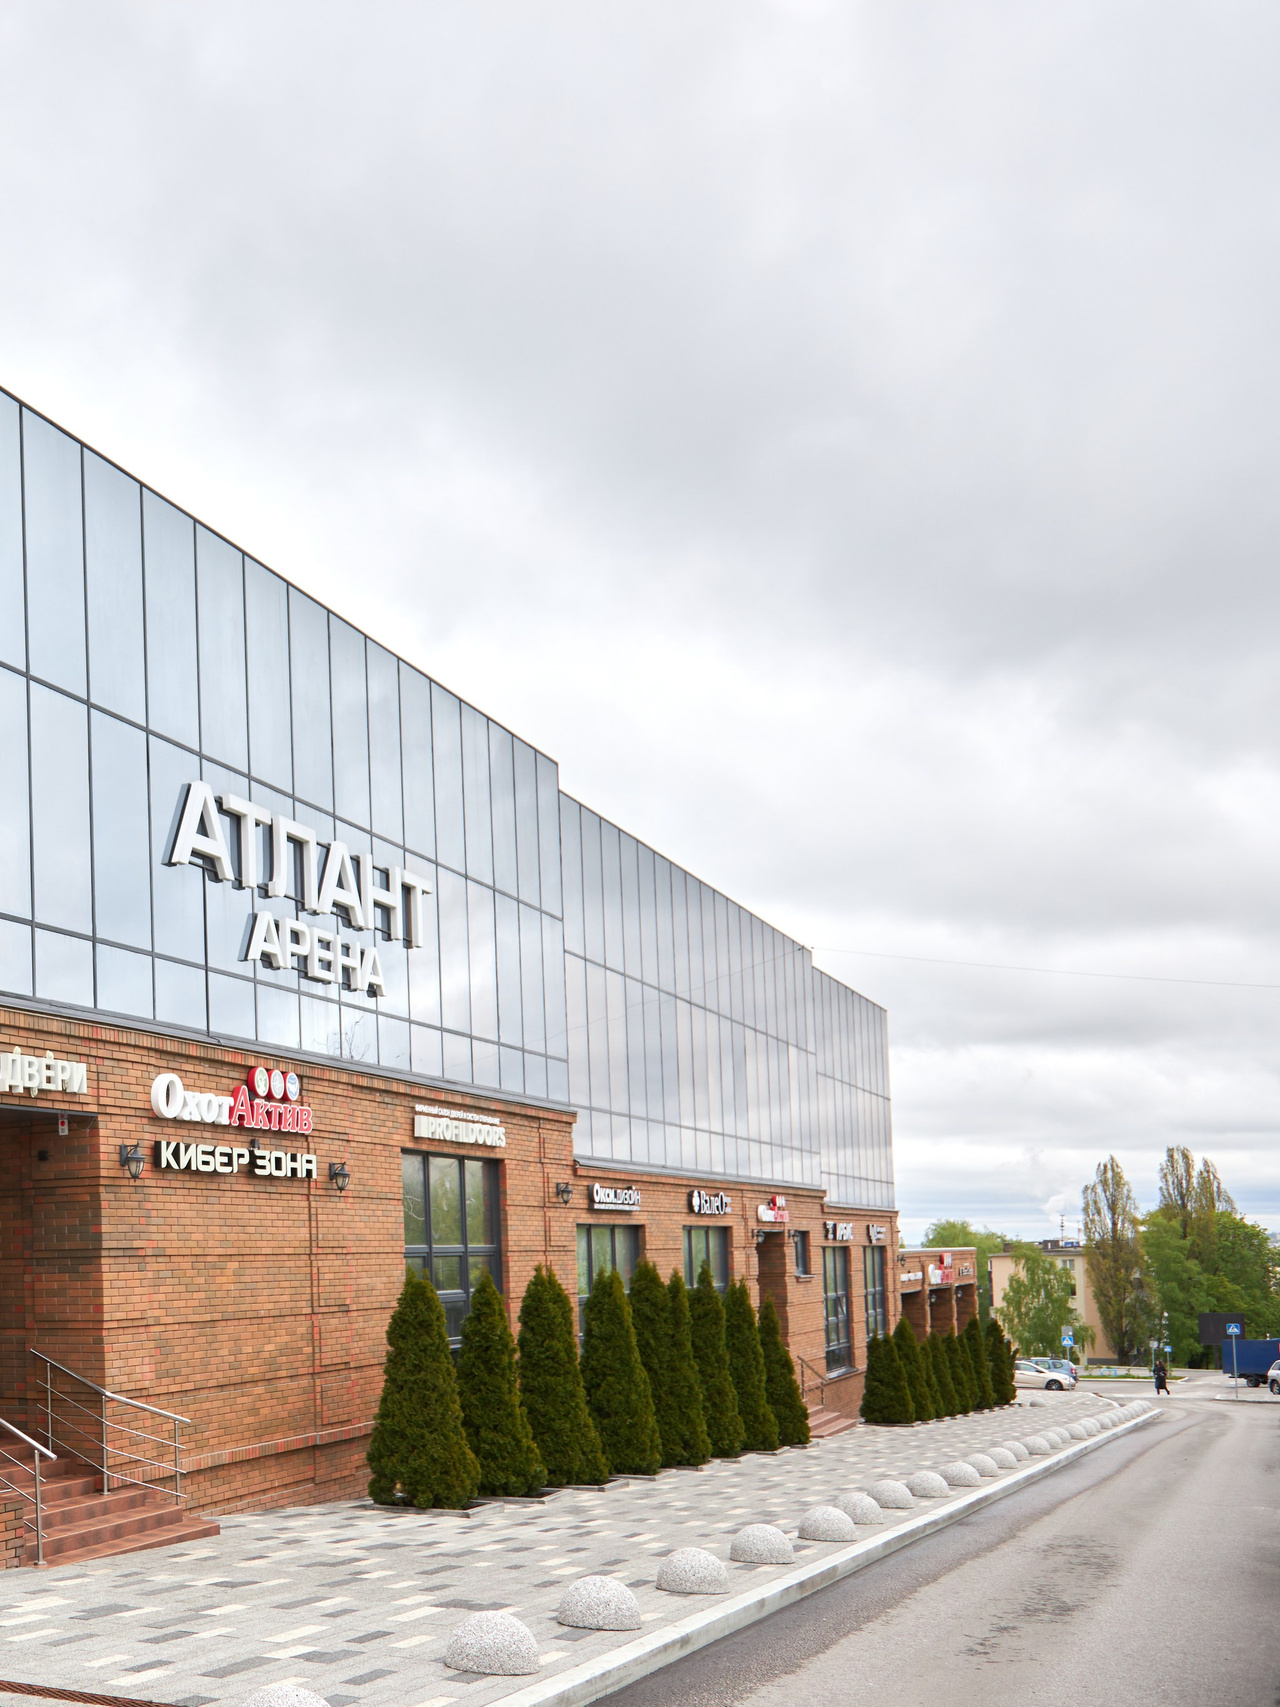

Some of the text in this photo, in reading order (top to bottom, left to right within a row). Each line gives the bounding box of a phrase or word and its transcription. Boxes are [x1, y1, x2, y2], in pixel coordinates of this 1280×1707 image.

[169, 780, 433, 949] АТЛАНТ
[245, 911, 386, 997] АРЕНА
[160, 1140, 317, 1179] КИБЕР ЗОНА
[429, 1116, 506, 1147] PROFILDOORS
